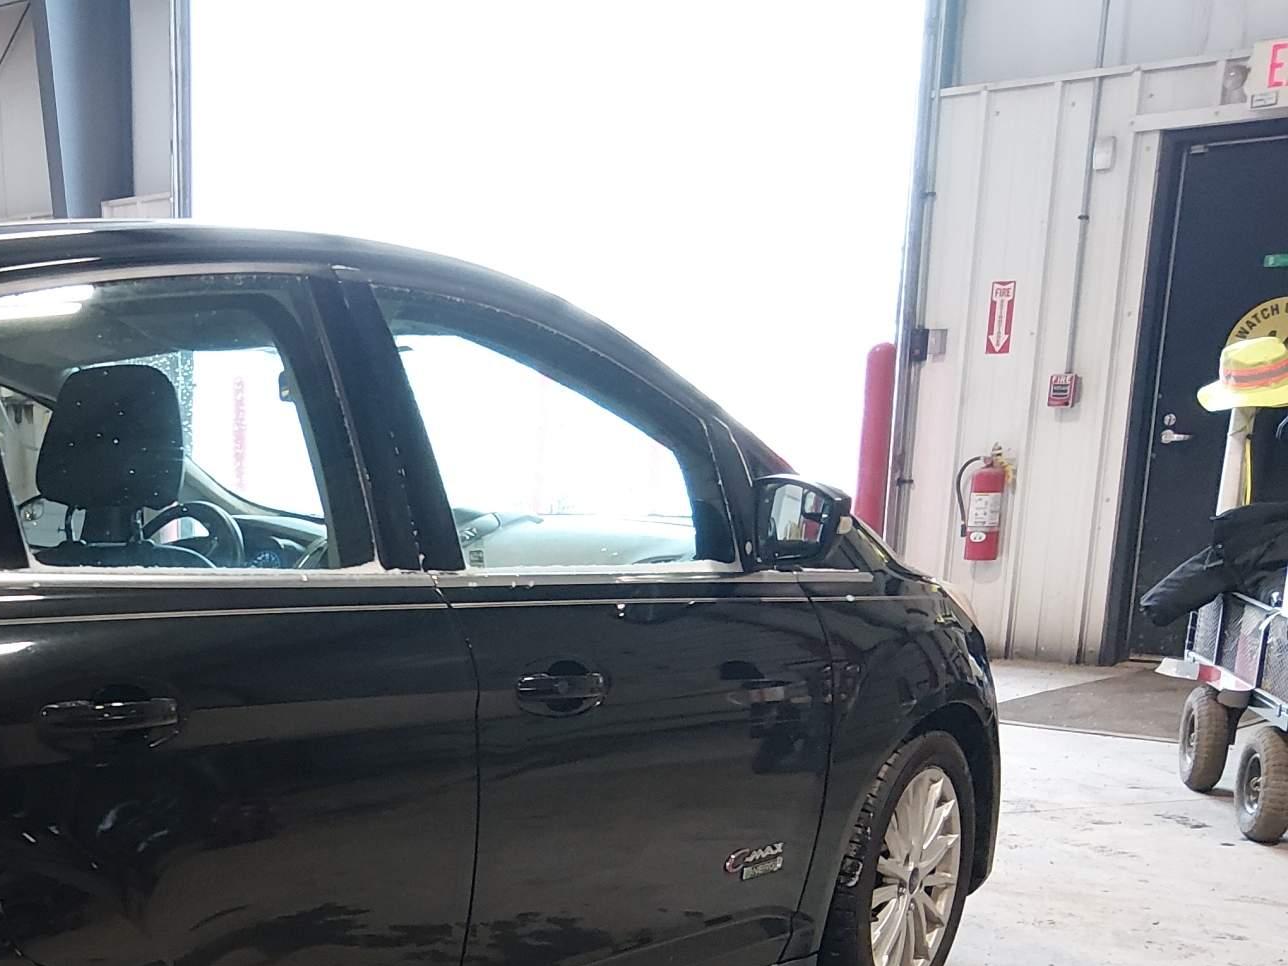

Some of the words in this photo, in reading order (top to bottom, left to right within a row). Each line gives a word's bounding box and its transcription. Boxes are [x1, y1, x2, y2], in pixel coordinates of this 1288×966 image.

[1268, 43, 1288, 88] E
[995, 288, 1012, 297] FIRE
[1235, 303, 1280, 339] WATCH
